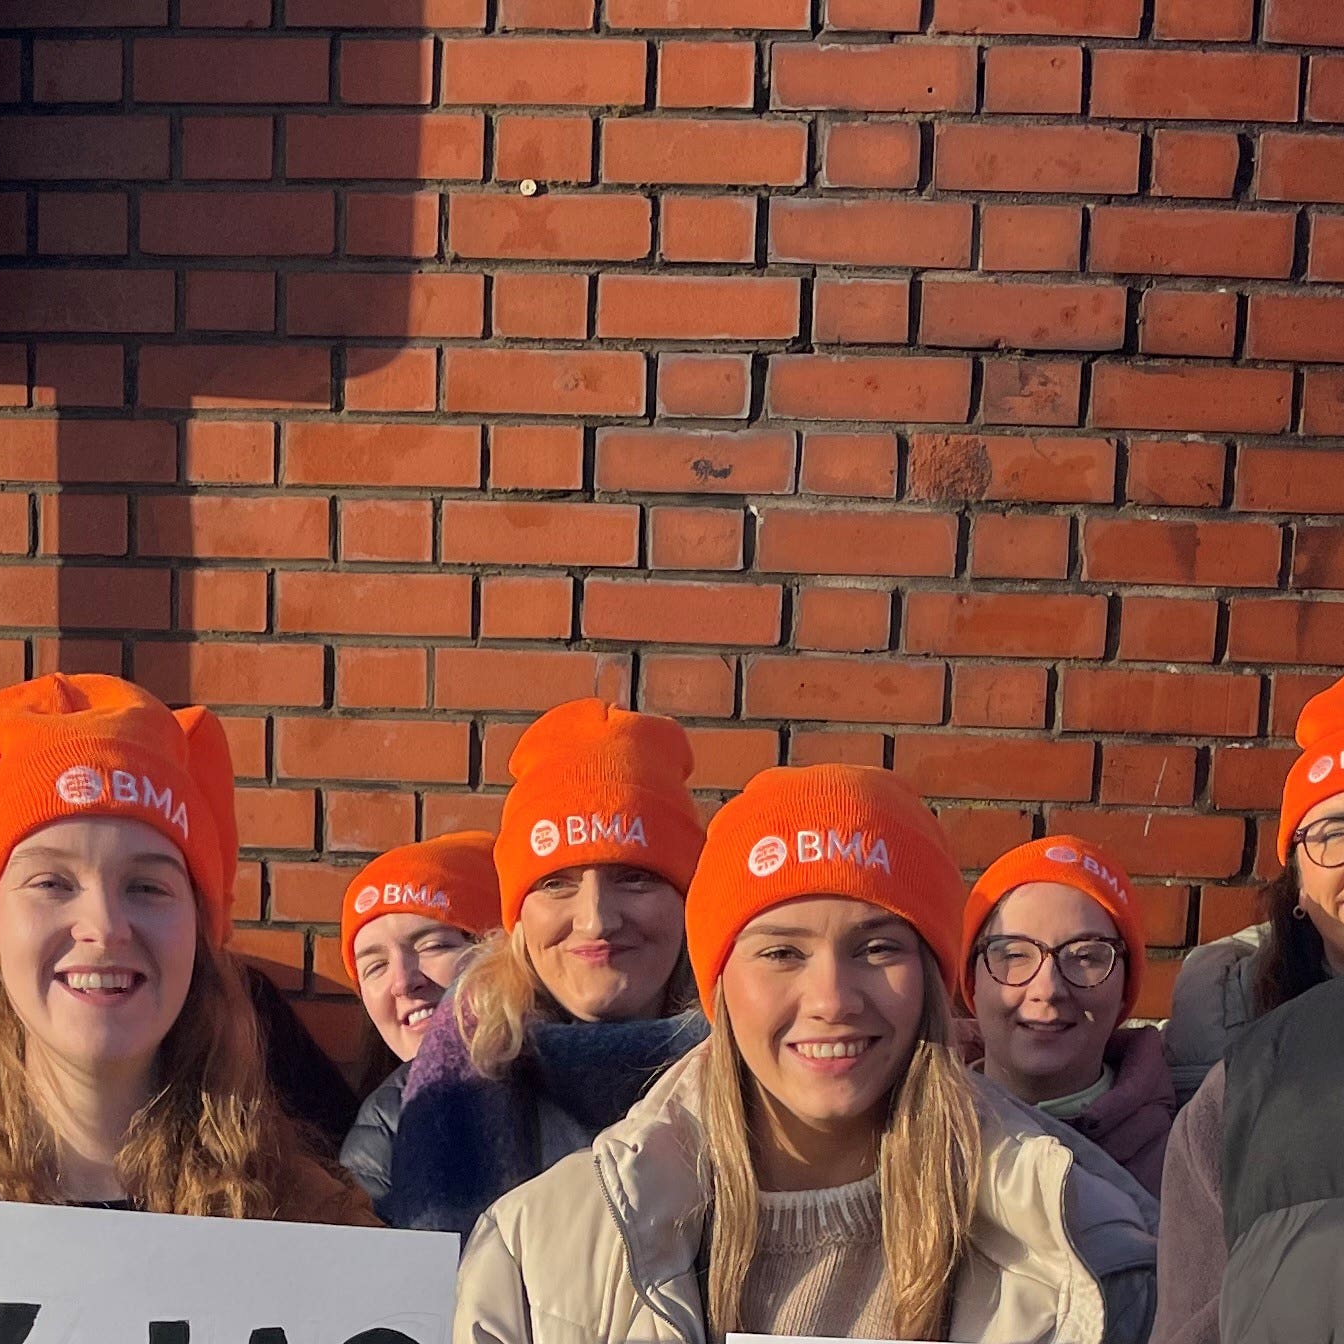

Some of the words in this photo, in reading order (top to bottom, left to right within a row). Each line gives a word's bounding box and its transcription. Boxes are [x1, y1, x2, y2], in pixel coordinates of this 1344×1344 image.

[110, 769, 189, 841] BMA
[566, 814, 648, 848] BMA
[797, 829, 892, 877] BMA
[383, 883, 451, 911] BMA
